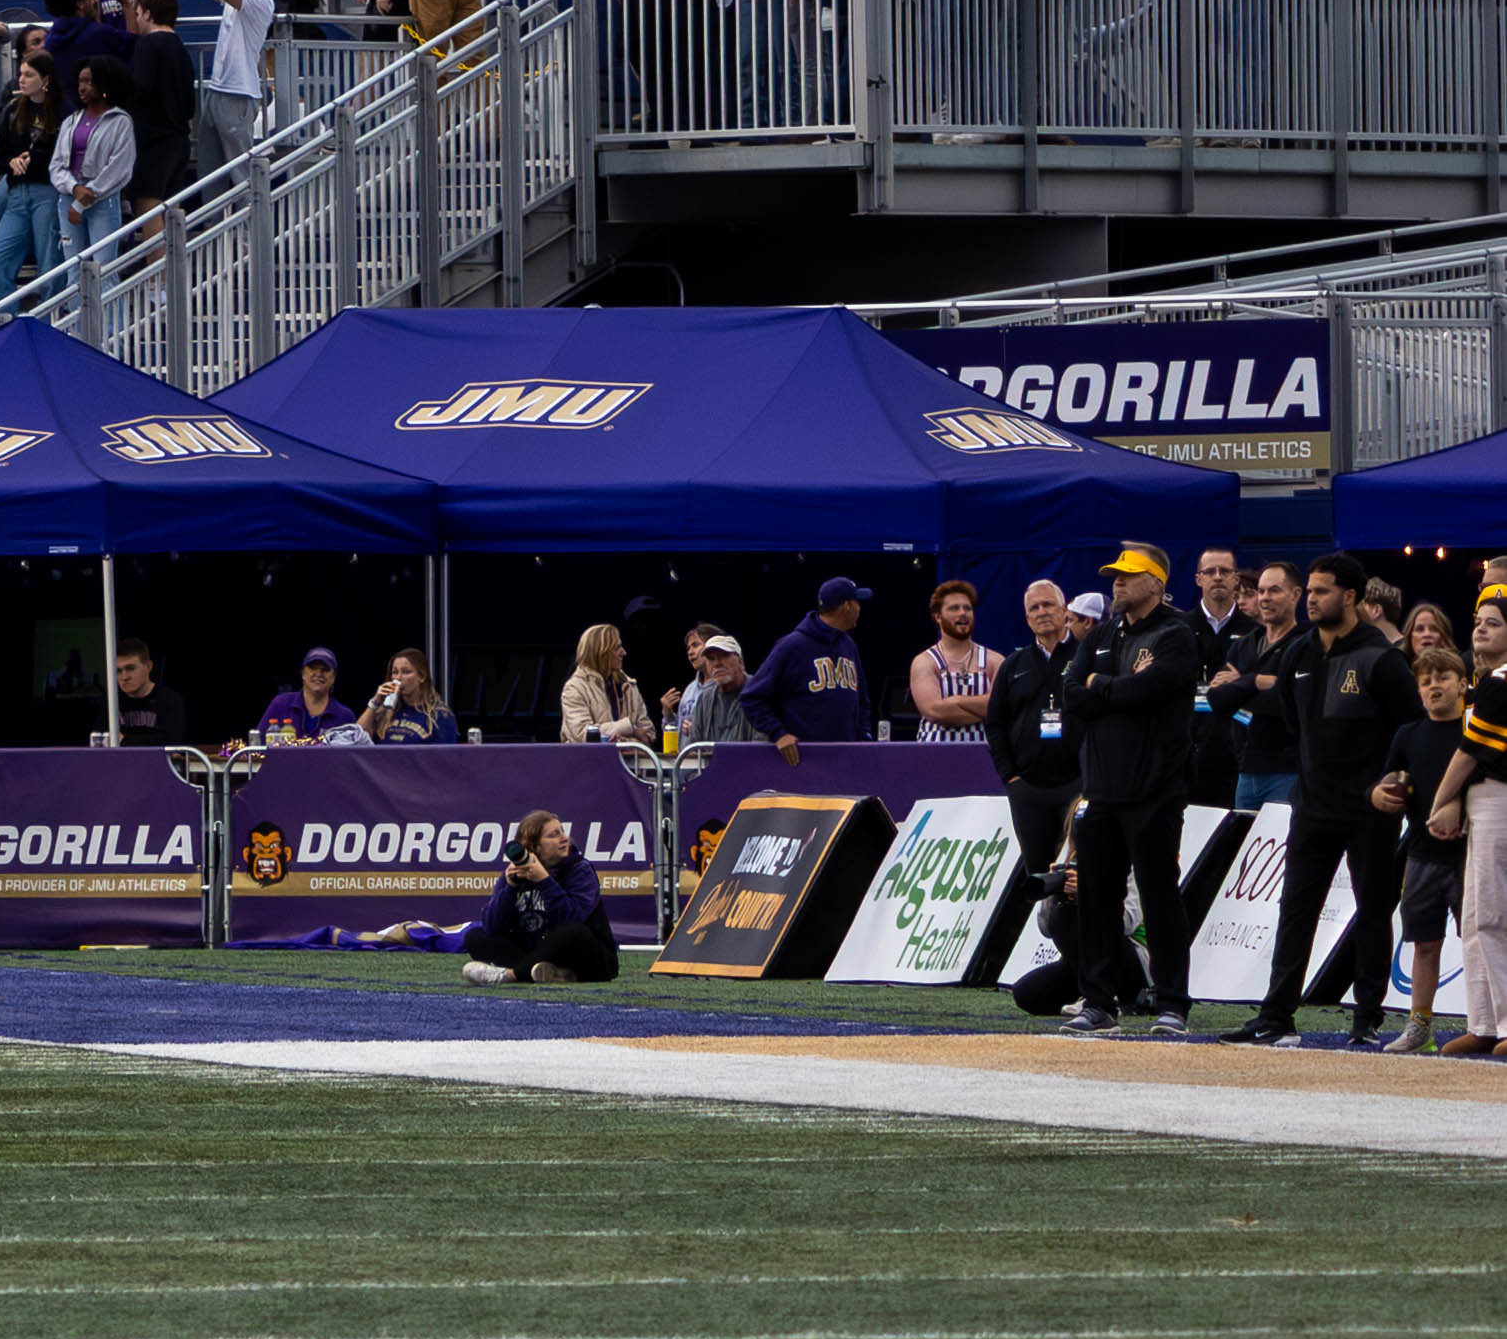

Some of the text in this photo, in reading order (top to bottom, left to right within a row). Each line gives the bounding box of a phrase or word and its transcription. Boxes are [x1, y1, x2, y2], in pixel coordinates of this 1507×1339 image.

[394, 378, 653, 430] JMU
[102, 413, 271, 464] JMU
[924, 407, 1083, 455] JMU
[1162, 443, 1204, 462] JMU
[1208, 440, 1312, 461] ATHLETICS
[809, 656, 859, 692] JMU
[1341, 670, 1359, 693] A
[732, 835, 790, 877] WELCOME
[874, 810, 1009, 930] Augusta
[5, 879, 67, 893] PROVIDER
[69, 879, 84, 893] OF
[87, 879, 116, 893] JMU
[118, 878, 186, 892] ATHLETICS
[310, 875, 639, 890] OFFICIAL GARAGE DOOR PROVI ETICS
[725, 889, 787, 931] COUNTRY
[897, 910, 973, 972] Health
[1200, 922, 1268, 950] INSURANCE
